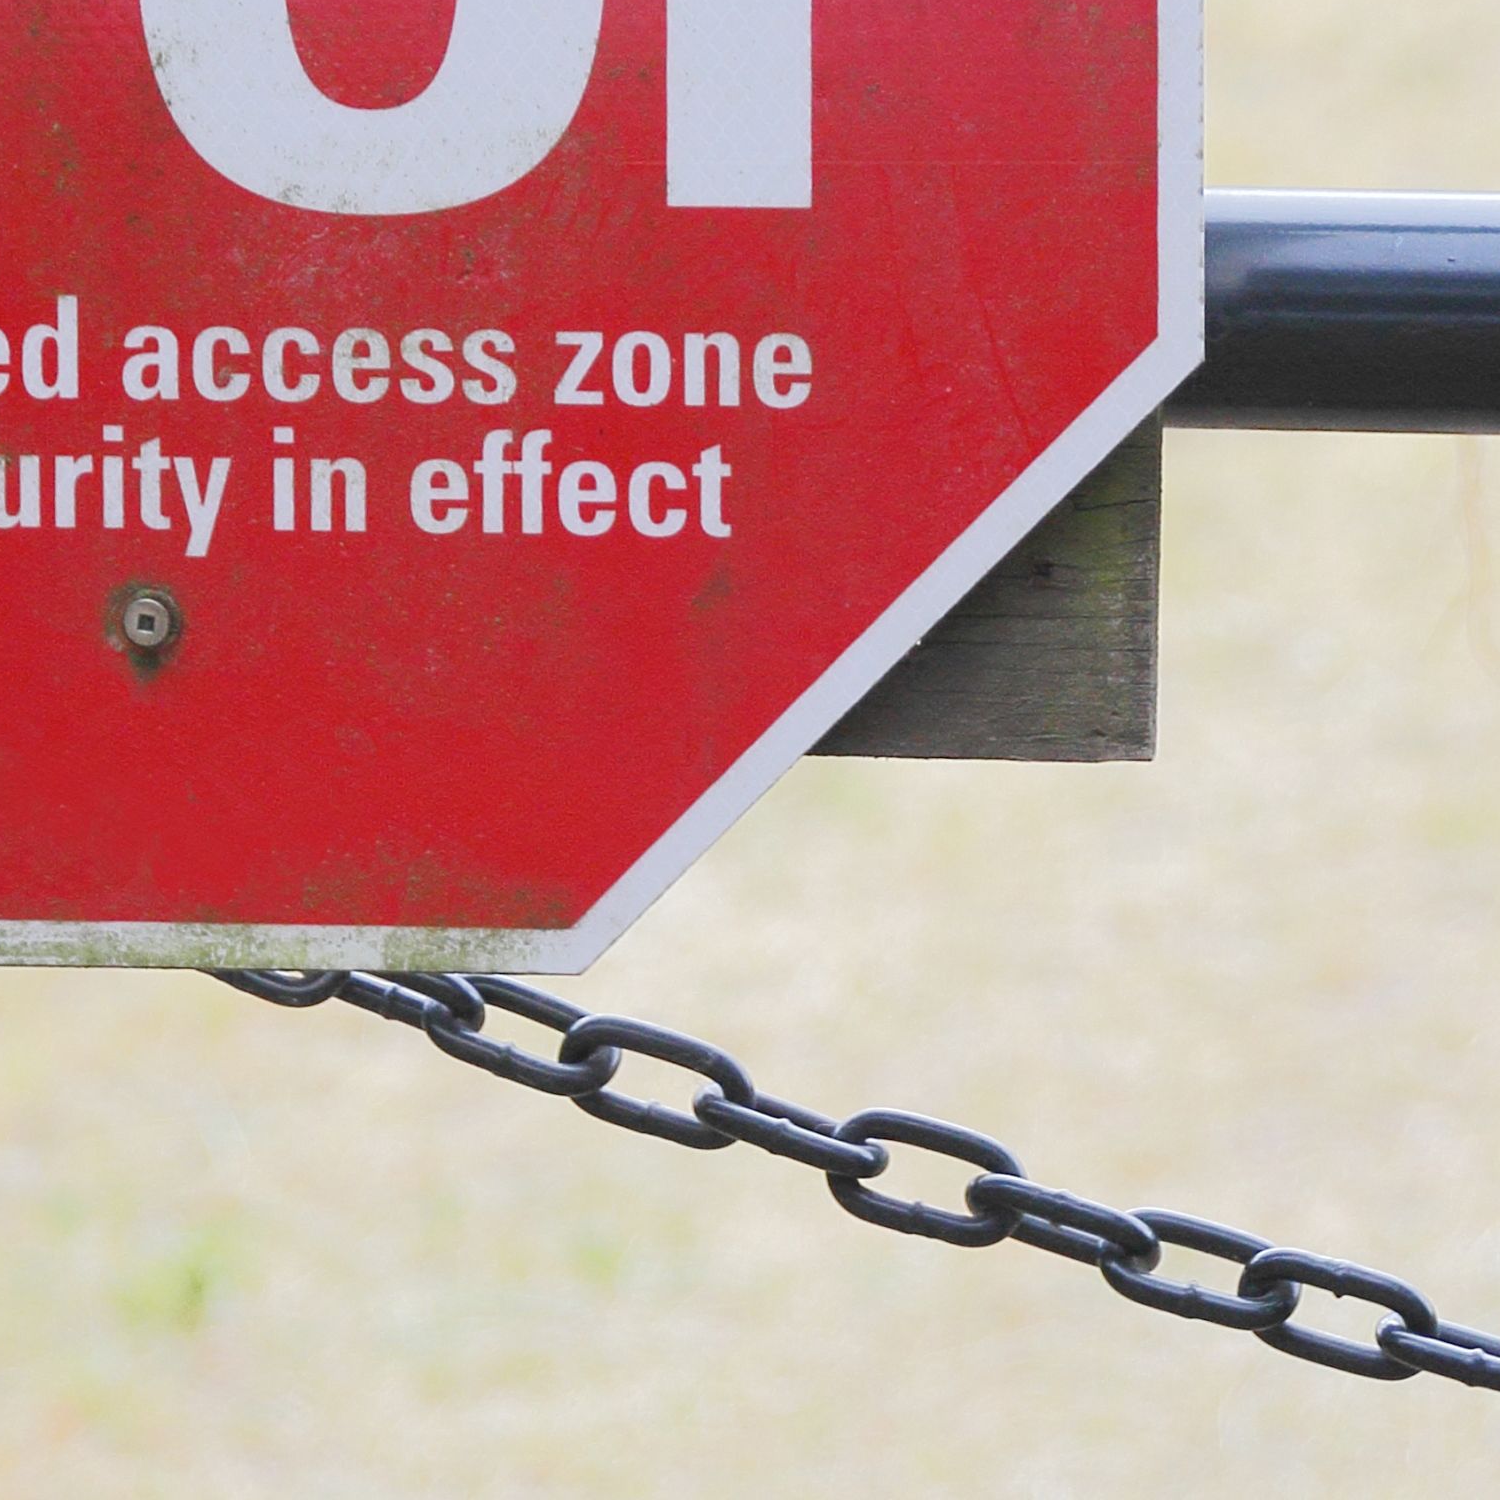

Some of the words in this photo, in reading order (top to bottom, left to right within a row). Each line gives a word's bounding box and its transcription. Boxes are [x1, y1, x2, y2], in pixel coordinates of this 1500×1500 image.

[121, 324, 518, 406] access
[553, 330, 813, 410] zone
[273, 426, 367, 533] in
[409, 428, 732, 538] effect
